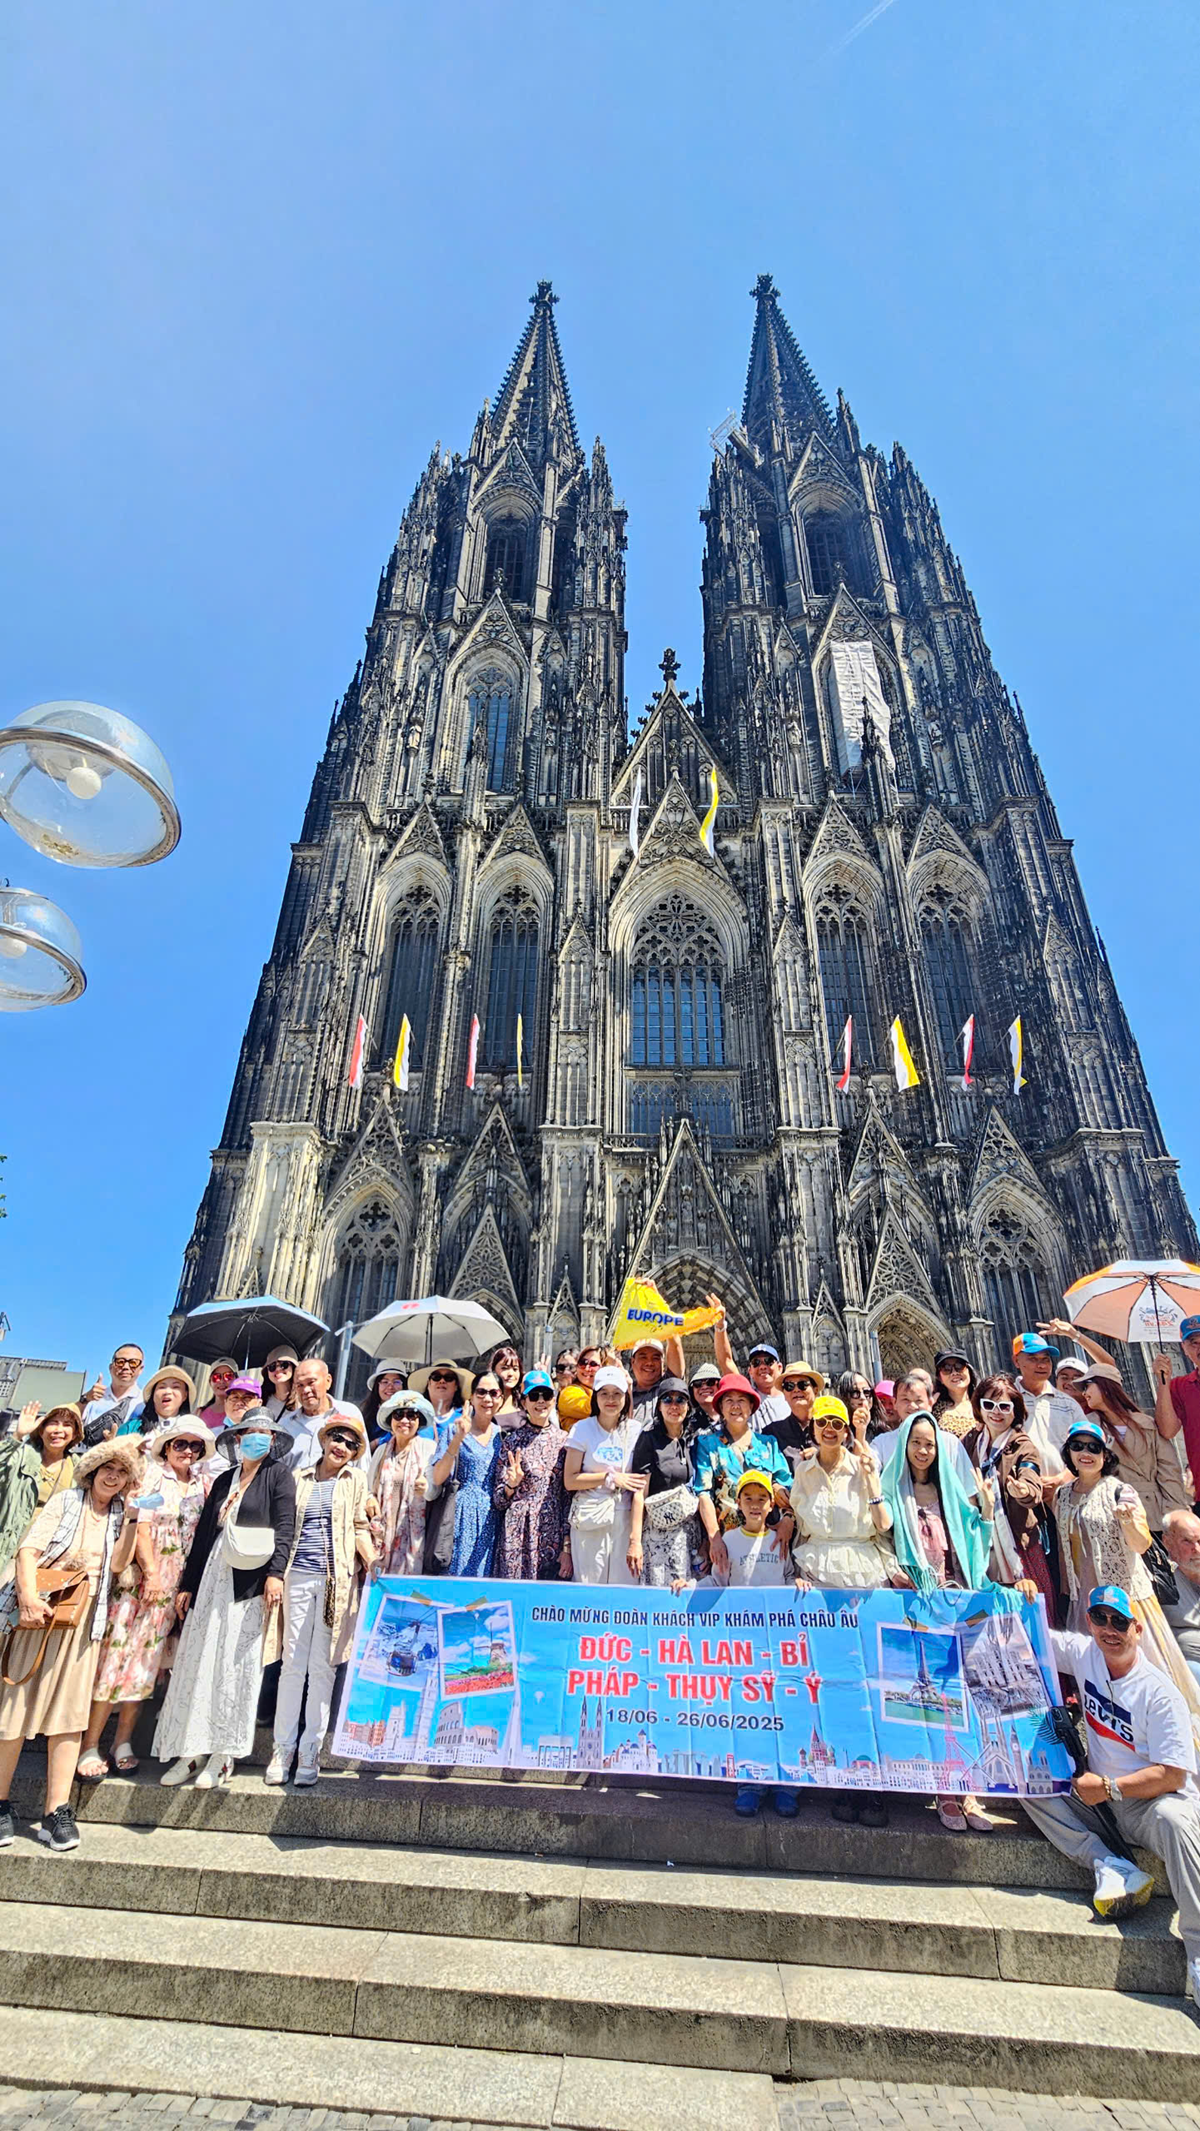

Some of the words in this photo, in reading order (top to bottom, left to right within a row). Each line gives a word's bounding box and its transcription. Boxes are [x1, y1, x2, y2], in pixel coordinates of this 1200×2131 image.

[627, 1308, 684, 1326] EUROPE
[532, 1604, 565, 1622] CHÀO
[570, 1606, 609, 1624] MỪNG
[614, 1608, 648, 1626] ĐOÀN
[653, 1610, 695, 1627] KHÁCH
[700, 1612, 720, 1627] VIP
[725, 1610, 764, 1627] KHÁM
[769, 1609, 796, 1627] PHÁ
[800, 1609, 836, 1628] CHÂU
[841, 1609, 858, 1628] ÂU
[580, 1632, 632, 1662] ĐỨC
[659, 1635, 694, 1664] HÀ
[702, 1640, 753, 1666] LAN
[780, 1633, 809, 1666] BỈ
[568, 1666, 639, 1696] PHÁP
[666, 1673, 733, 1706] THỤY
[743, 1671, 776, 1702] SỸ
[805, 1672, 821, 1704] Ý
[607, 1709, 658, 1724] 18/06
[677, 1712, 785, 1731] 26/06/2025
